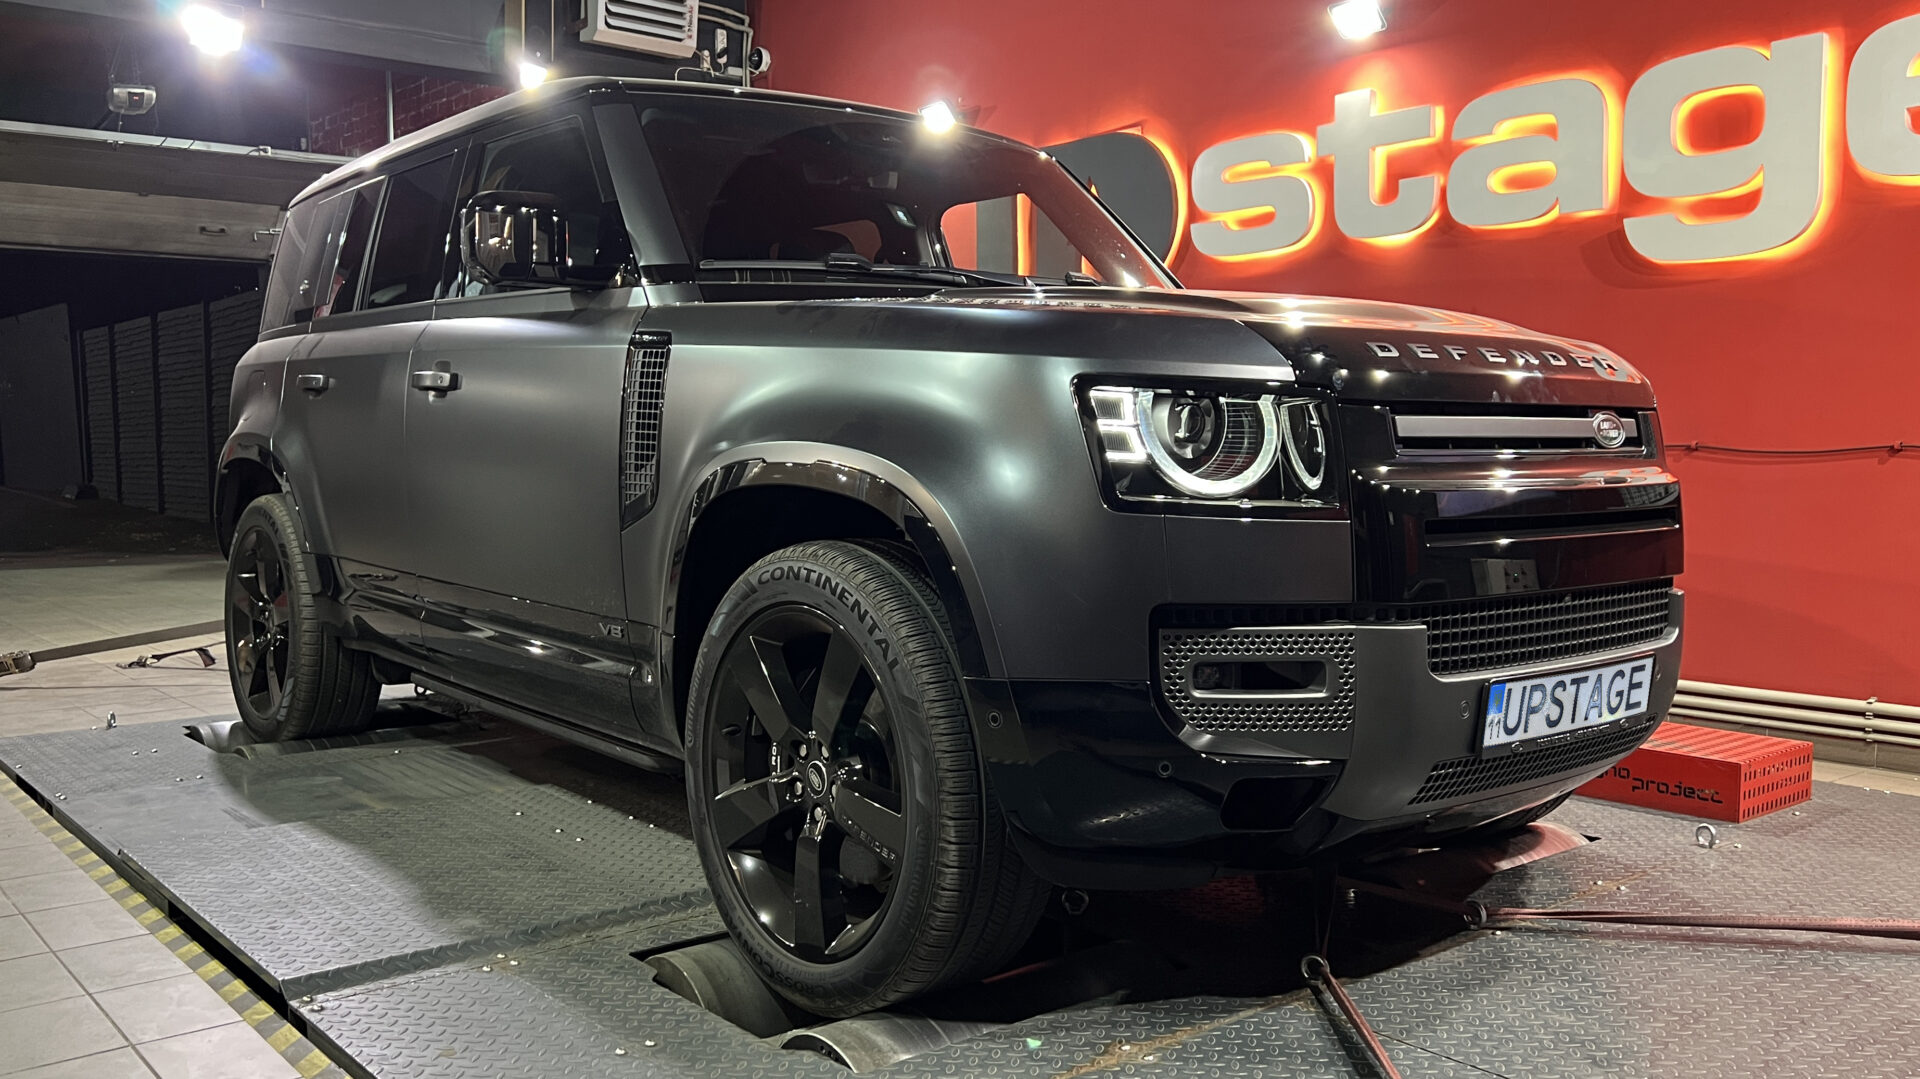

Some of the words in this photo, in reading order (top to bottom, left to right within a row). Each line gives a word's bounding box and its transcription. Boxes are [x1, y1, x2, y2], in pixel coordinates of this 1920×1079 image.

[1366, 341, 1619, 371] DEFENDER
[598, 622, 623, 638] V8
[757, 565, 900, 681] CONTINENTAL
[1503, 664, 1646, 736] UPSTAGE
[1632, 777, 1724, 804] project
